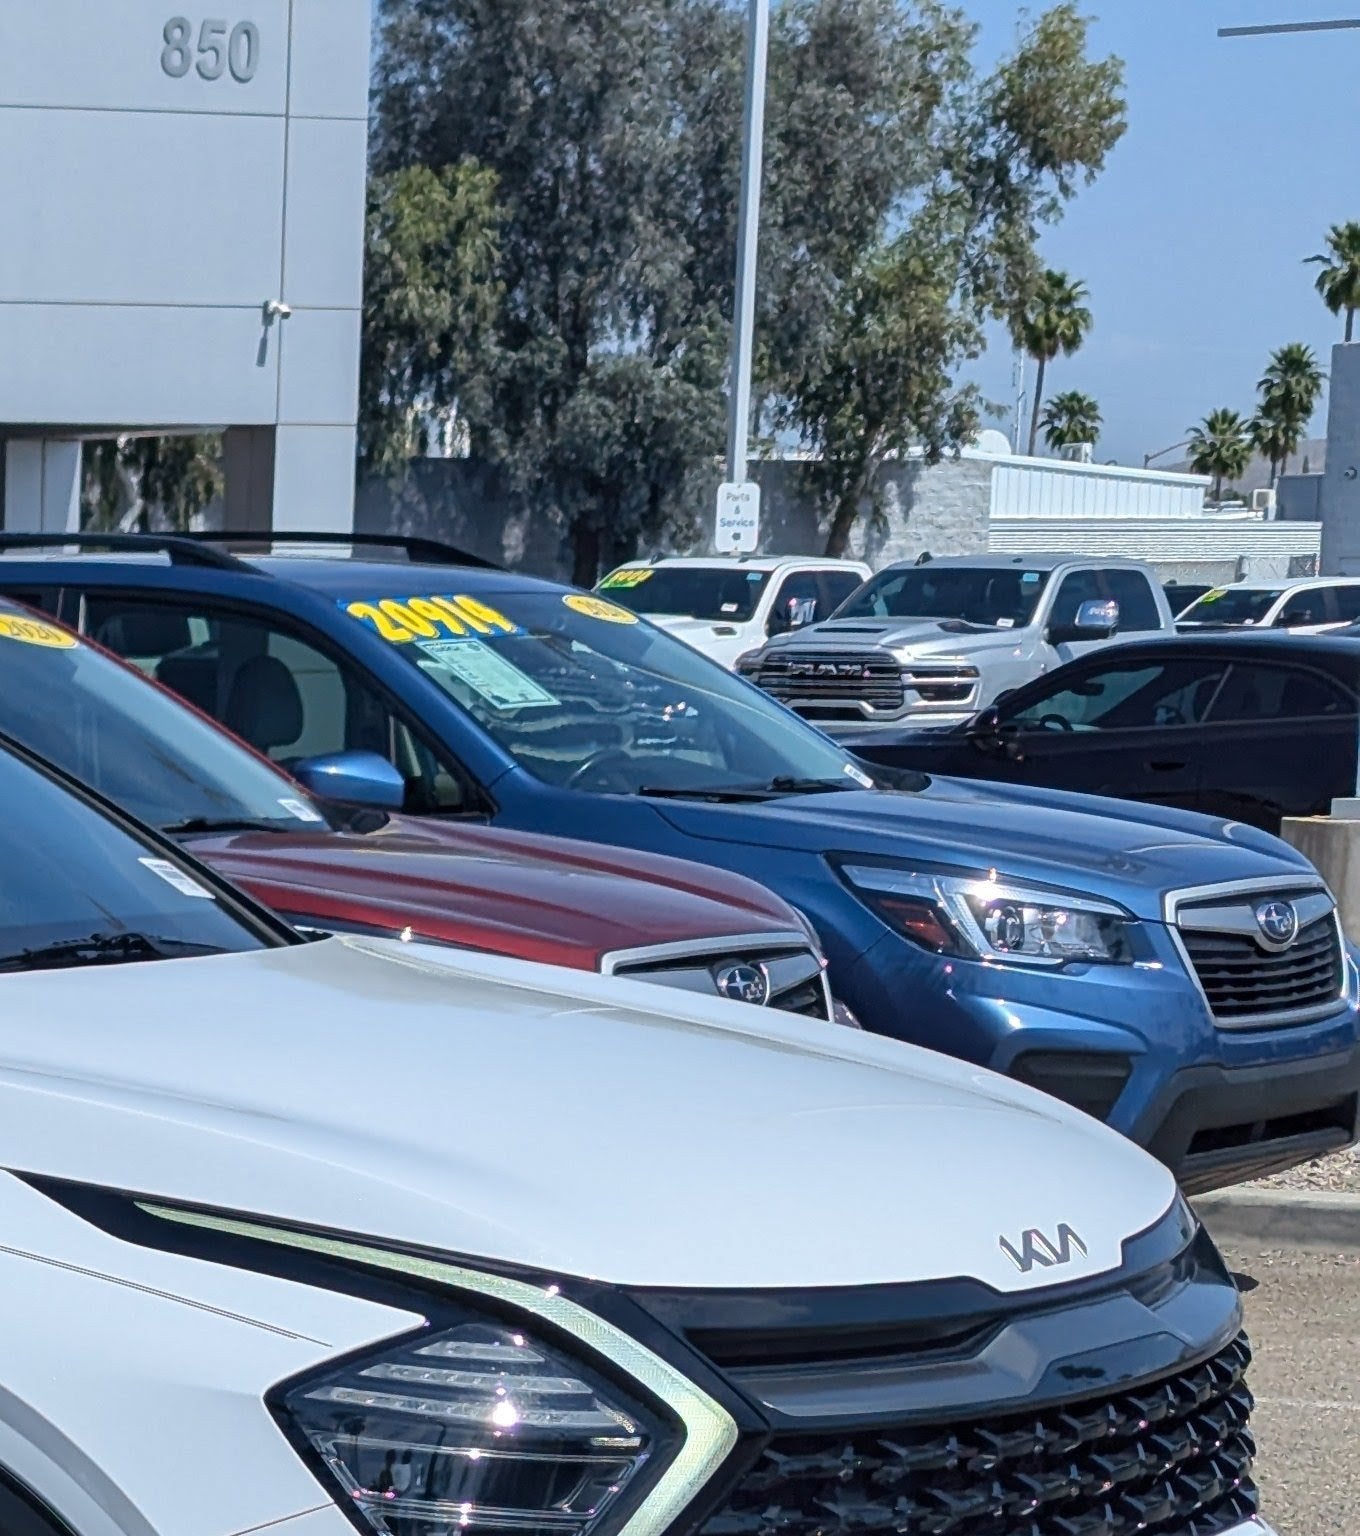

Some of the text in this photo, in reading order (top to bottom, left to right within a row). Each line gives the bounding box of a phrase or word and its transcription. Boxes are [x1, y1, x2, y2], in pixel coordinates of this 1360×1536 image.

[160, 16, 260, 84] 850
[726, 492, 750, 502] Parts
[720, 517, 755, 528] Service
[346, 595, 516, 643] 20914
[999, 1222, 1088, 1273] KIA
